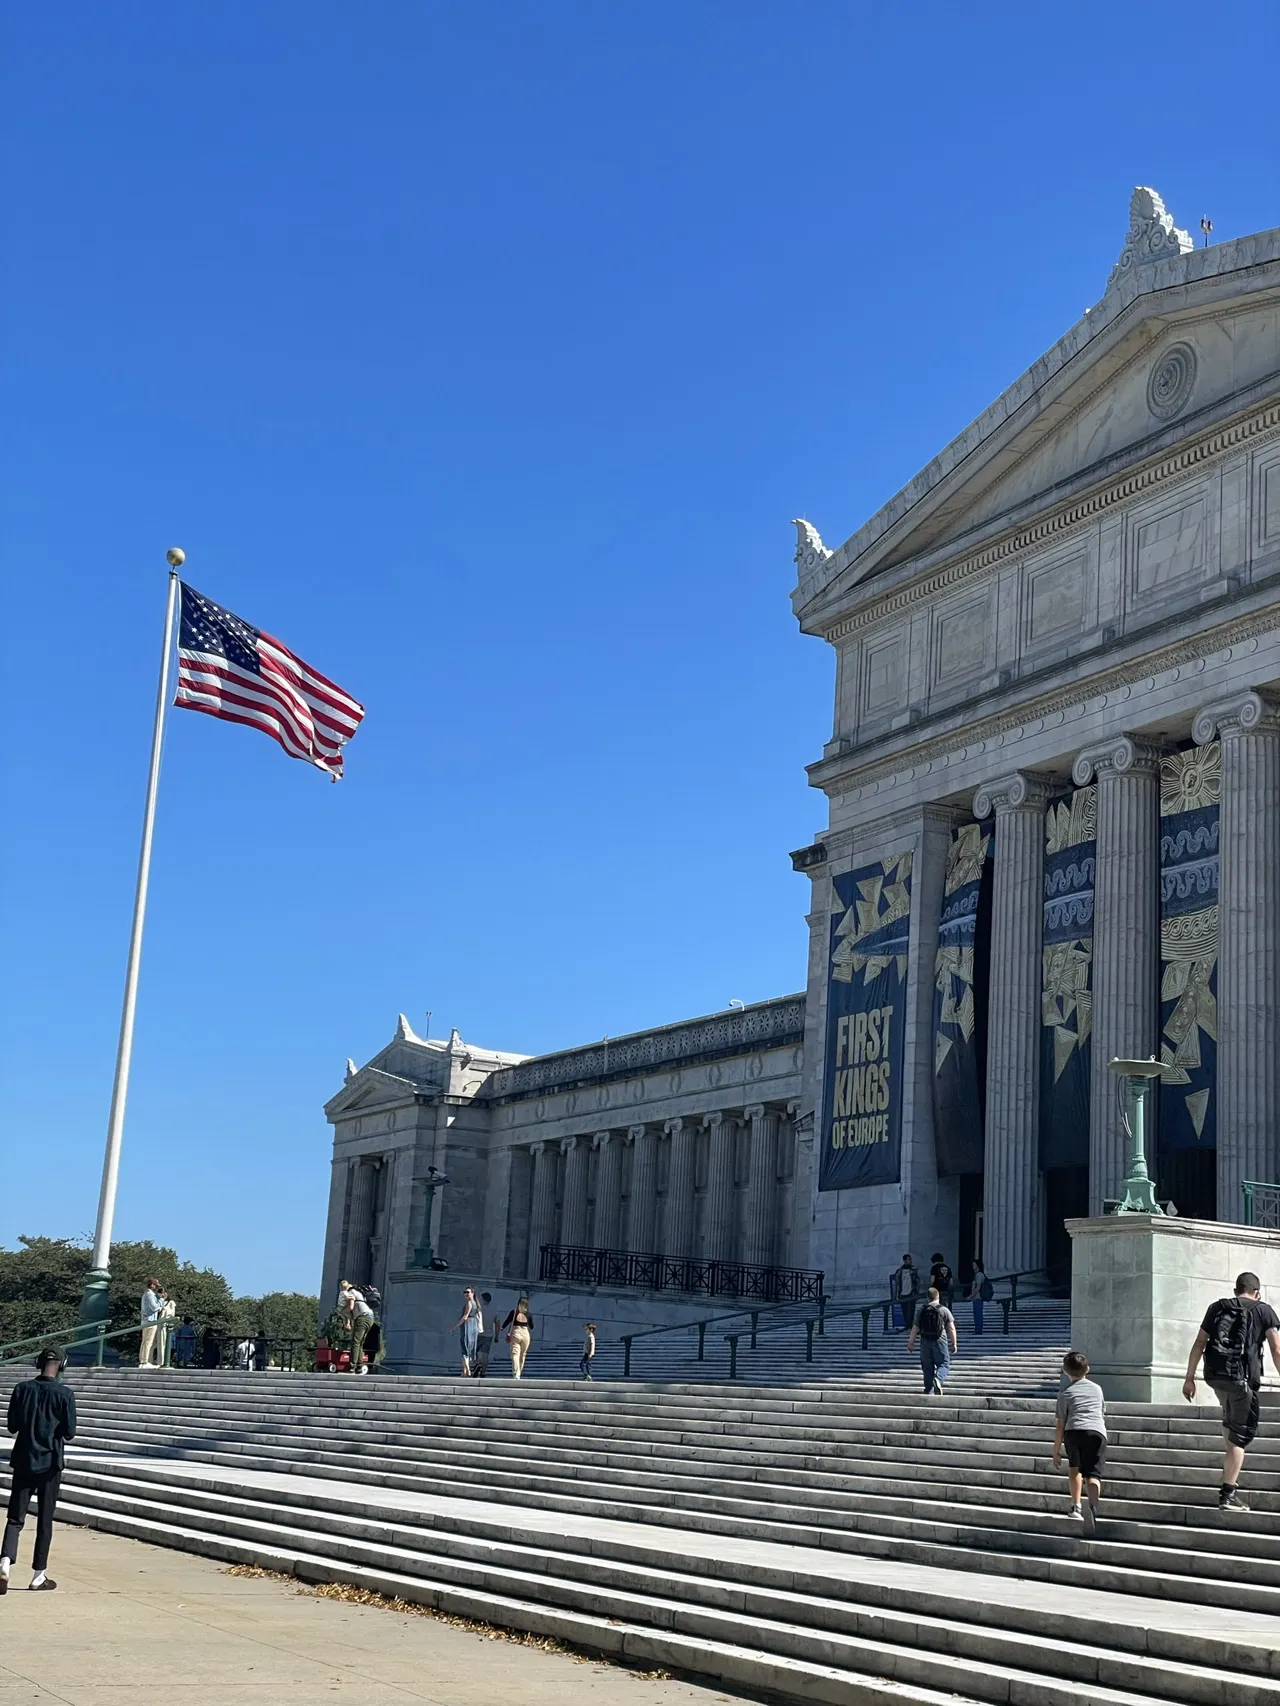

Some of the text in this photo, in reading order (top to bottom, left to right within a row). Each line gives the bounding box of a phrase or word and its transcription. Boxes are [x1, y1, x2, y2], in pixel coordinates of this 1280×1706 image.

[837, 1005, 893, 1067] FIRST
[832, 1060, 890, 1118] KINGS
[832, 1114, 889, 1150] OF EUROPE
